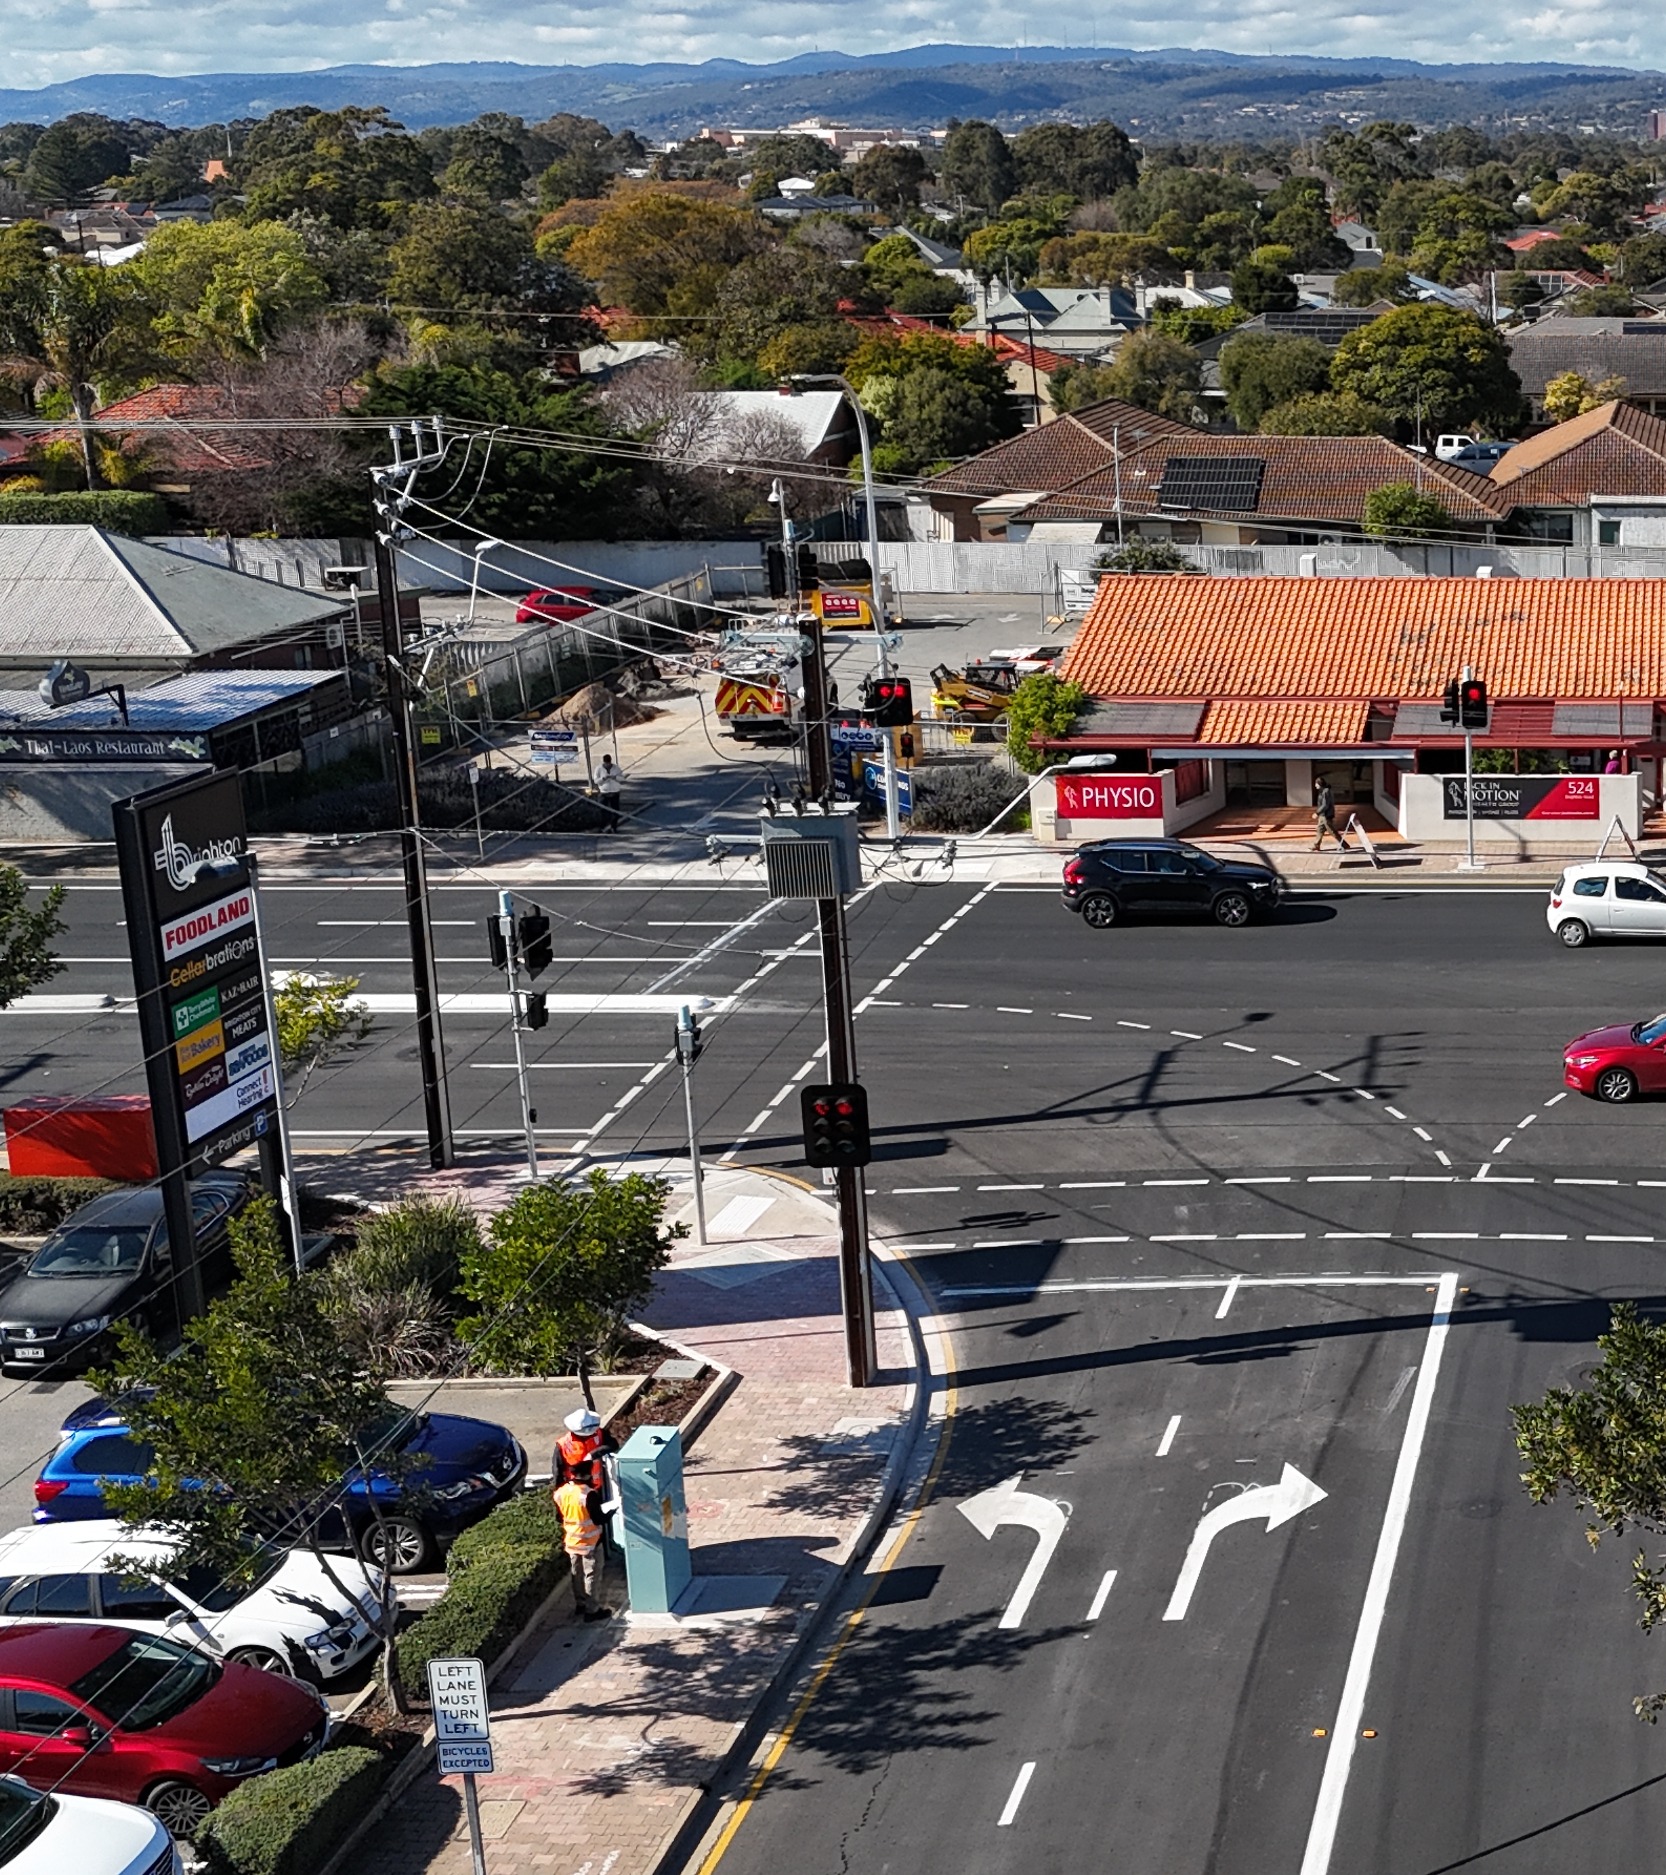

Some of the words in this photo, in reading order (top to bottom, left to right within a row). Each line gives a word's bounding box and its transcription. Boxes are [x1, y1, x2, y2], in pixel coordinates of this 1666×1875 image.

[97, 739, 165, 755] Restaurant
[1489, 782, 1500, 790] IN
[1568, 781, 1594, 794] 524
[1082, 787, 1154, 808] PHYSIO
[164, 896, 250, 951] FOODLAND
[170, 936, 255, 988] Cellarbrations
[232, 1016, 257, 1039] MEATS
[218, 1128, 252, 1153] Parking
[438, 1666, 472, 1677] LEFT
[437, 1681, 477, 1691] LANE
[439, 1695, 477, 1705] MUST
[440, 1709, 479, 1720] TURN
[444, 1723, 479, 1734] LEFT
[442, 1747, 488, 1756] BICYCLES
[442, 1759, 490, 1768] EXCEPTED
